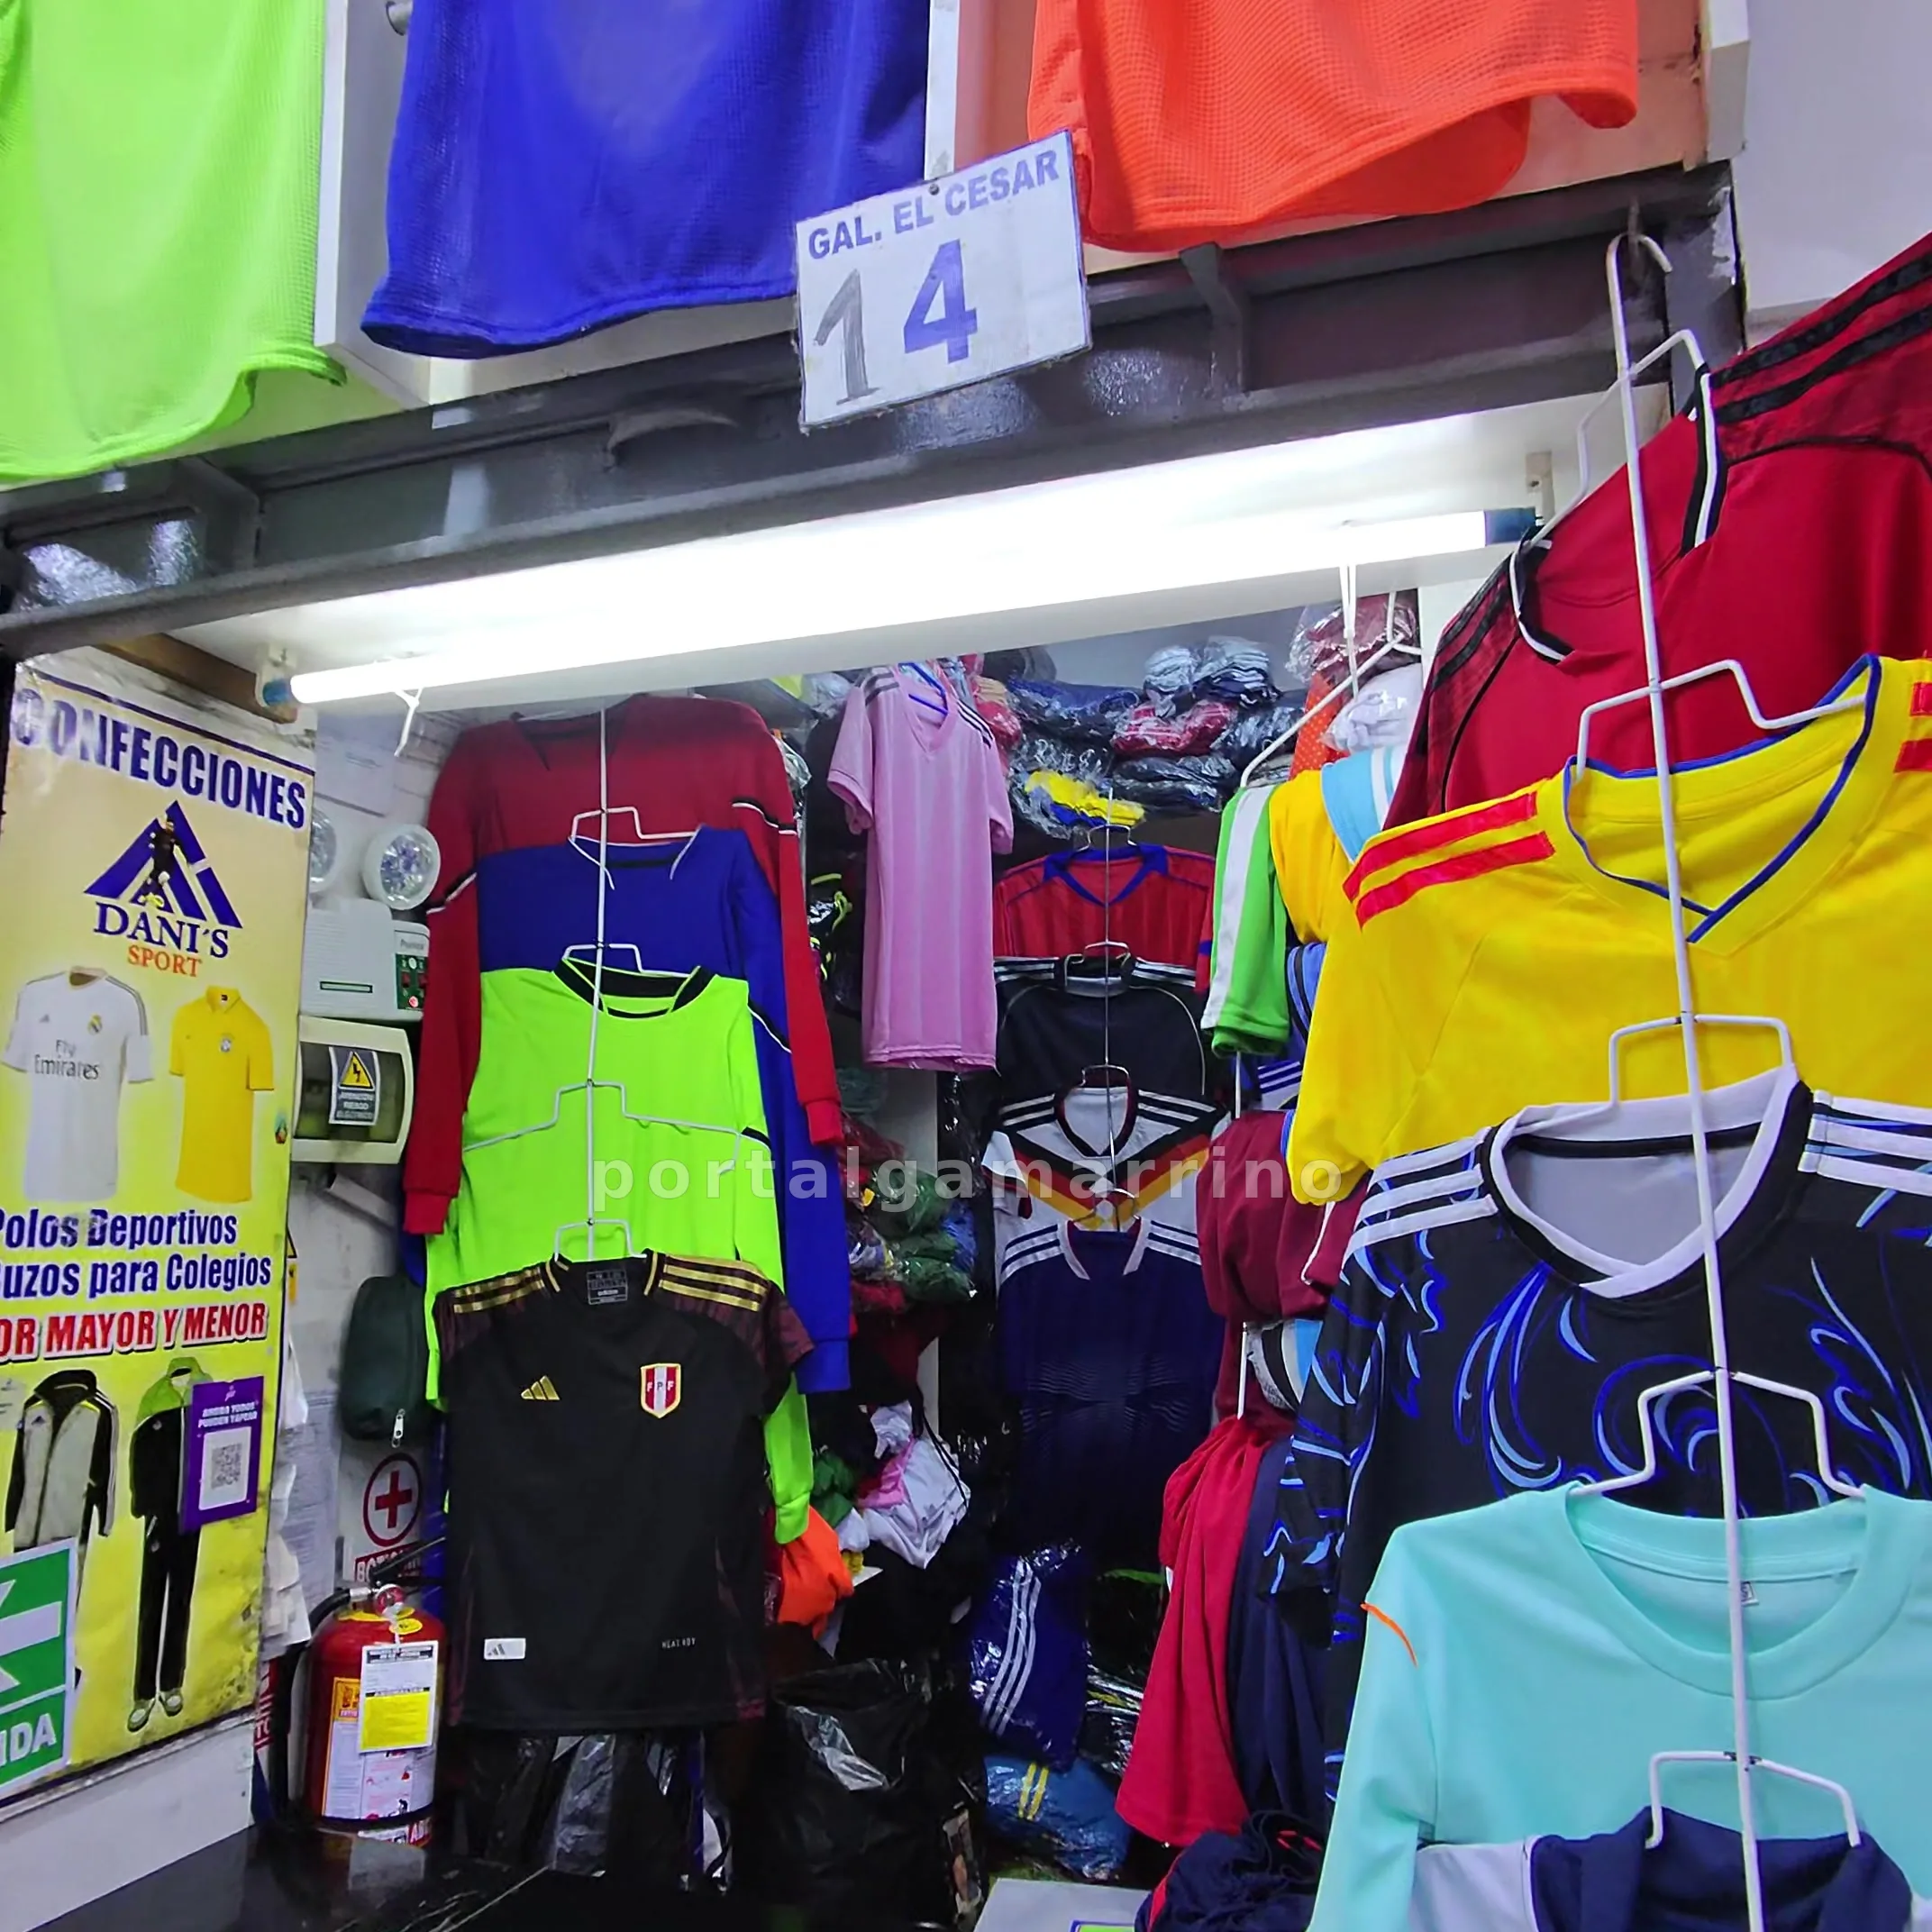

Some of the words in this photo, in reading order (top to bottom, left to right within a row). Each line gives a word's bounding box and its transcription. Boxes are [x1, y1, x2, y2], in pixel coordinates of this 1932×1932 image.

[808, 216, 882, 260] GAL.
[893, 196, 934, 234] EL
[945, 150, 1060, 216] CESAR
[127, 944, 203, 977] SPORT
[87, 1208, 238, 1250] Deportivos
[3, 1262, 80, 1299] uzos
[88, 1261, 159, 1299] para
[166, 1253, 271, 1291] Colegios
[0, 1318, 37, 1357] OR
[46, 1310, 156, 1353] MAYOR
[163, 1308, 178, 1342] Y
[184, 1303, 266, 1341] MENOR
[0, 1713, 57, 1766] IDA
